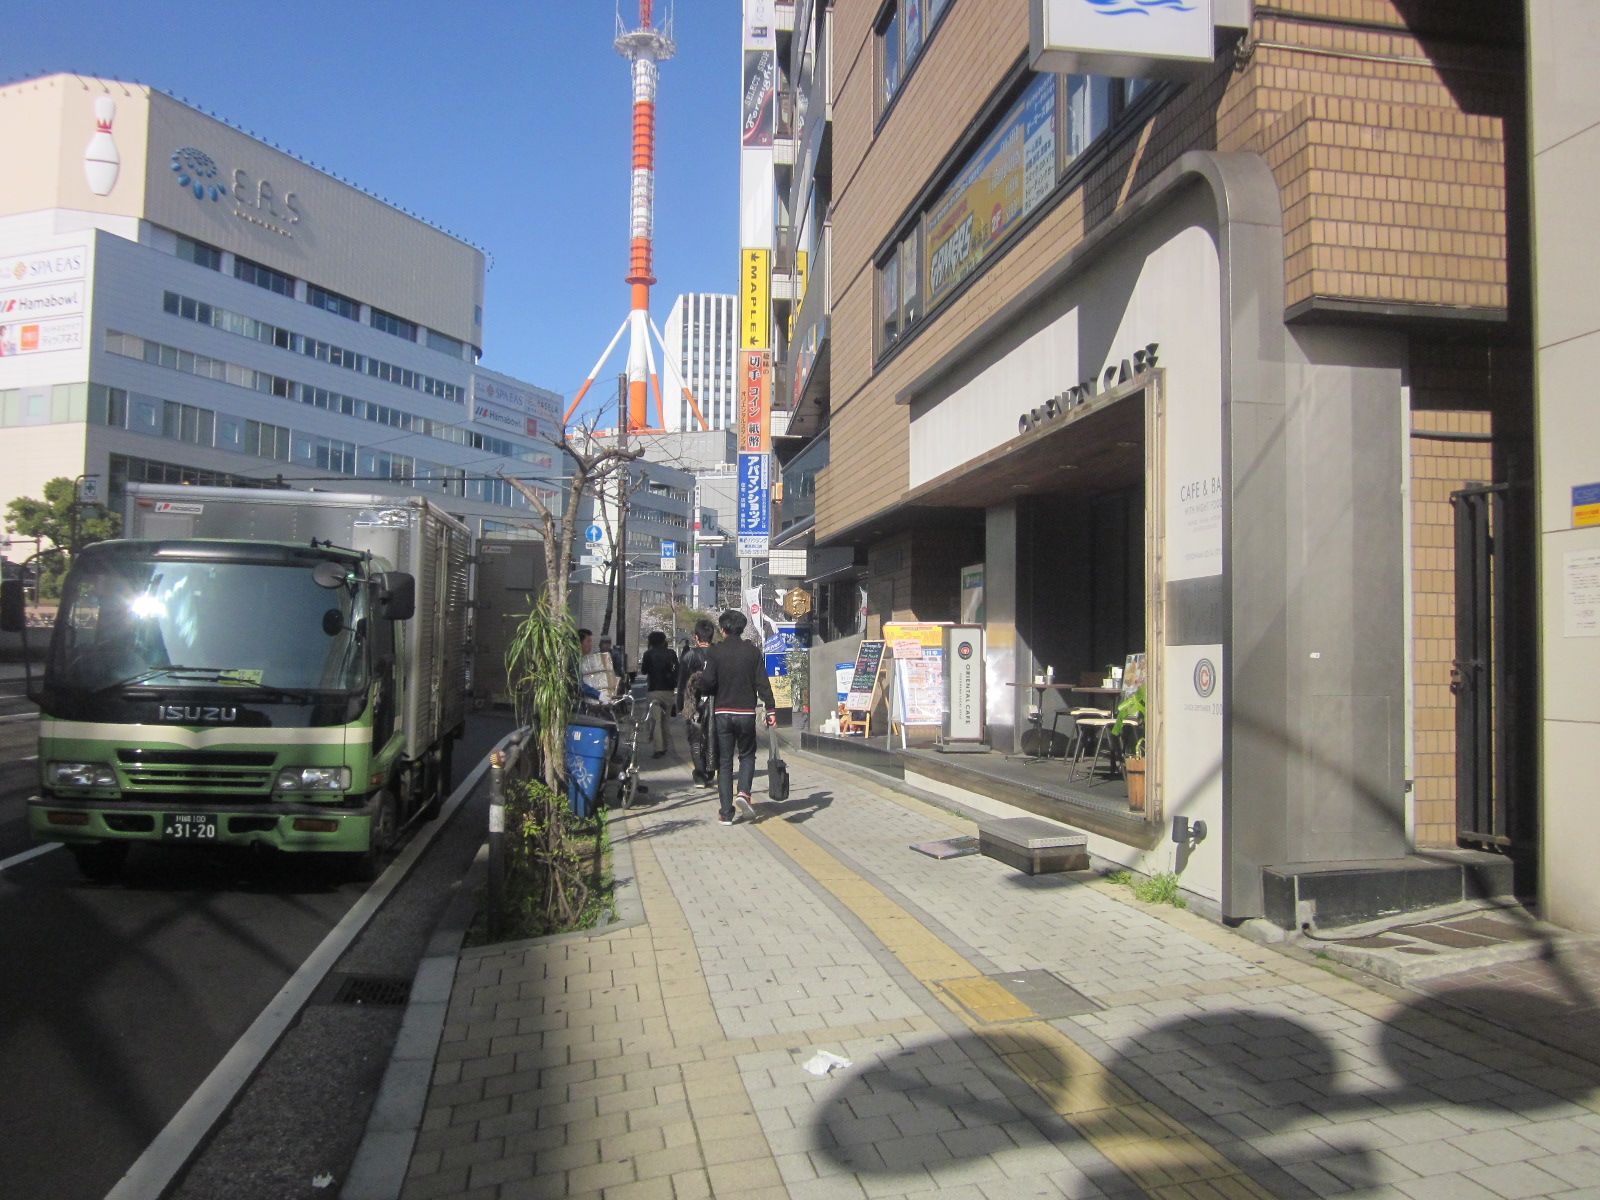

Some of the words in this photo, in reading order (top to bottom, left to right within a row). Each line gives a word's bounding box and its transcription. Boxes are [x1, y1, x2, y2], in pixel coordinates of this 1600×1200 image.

[30, 260, 53, 277] SPA
[56, 256, 81, 273] EAS
[19, 291, 79, 311] Hamabowl
[750, 265, 758, 333] MAPLE
[749, 356, 761, 381] 切手
[1103, 343, 1160, 392] CAFE
[749, 387, 760, 417] コイン
[747, 456, 760, 529] アパマンショップ
[1180, 481, 1201, 503] CAFE
[1203, 480, 1208, 497] &
[160, 705, 236, 721] ISUZU
[174, 823, 215, 838] 31-20
